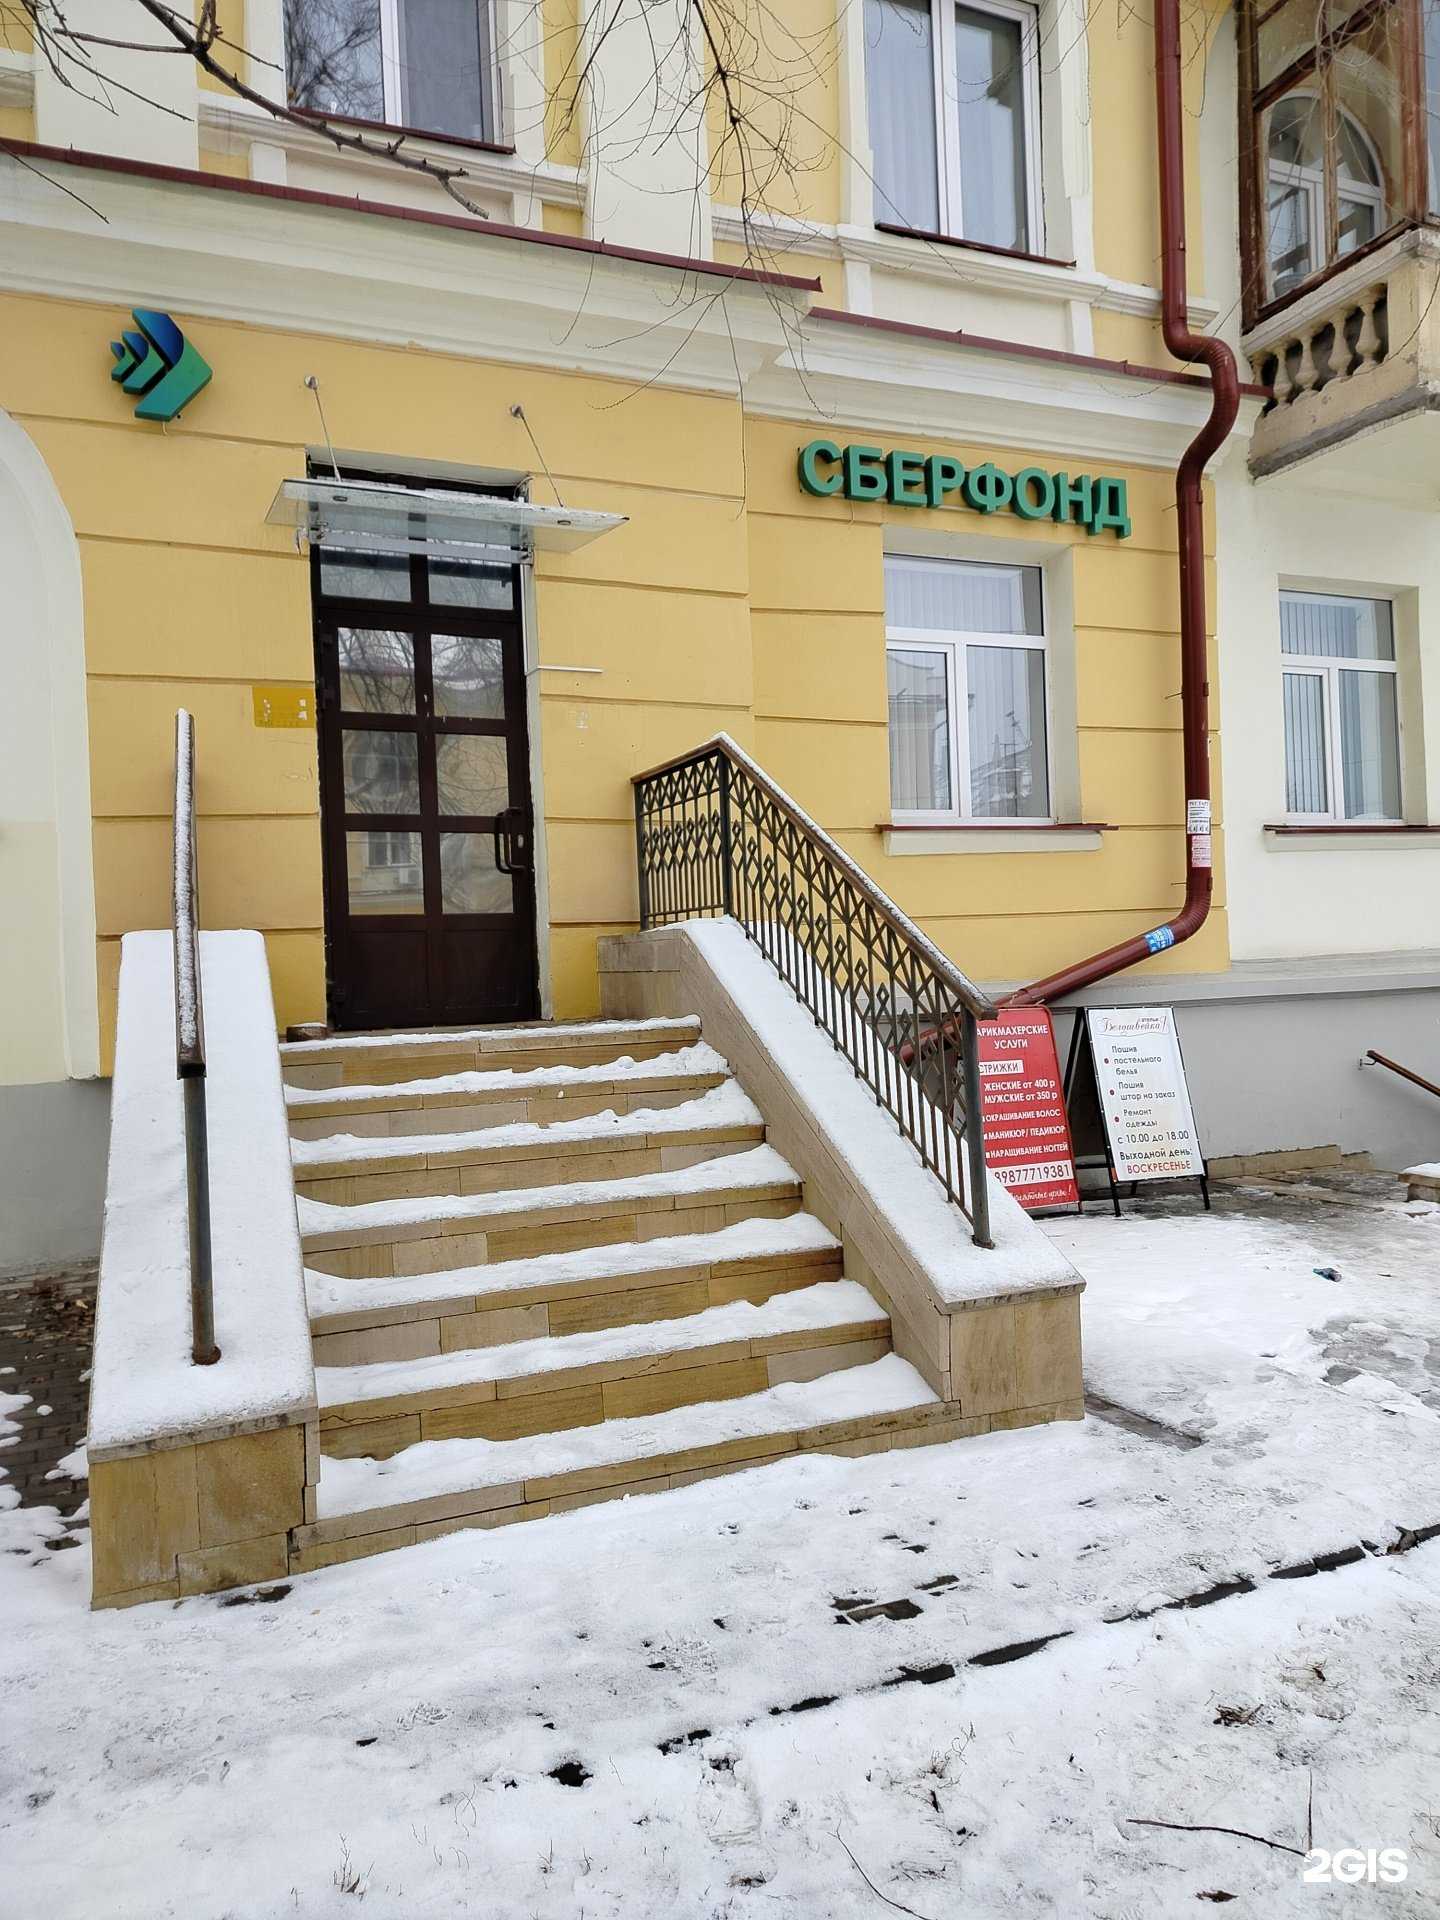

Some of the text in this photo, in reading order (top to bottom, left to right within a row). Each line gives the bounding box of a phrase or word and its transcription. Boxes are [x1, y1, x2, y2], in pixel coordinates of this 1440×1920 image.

[799, 439, 1131, 538] СБЕРФОНД
[976, 1024, 1048, 1037] АРИКМАХЕРСКИЕ
[994, 1039, 1028, 1050] УСЛУГИ
[1112, 1045, 1137, 1053] Пошив
[1113, 1056, 1162, 1064] постельного
[1116, 1067, 1138, 1075] белья
[984, 1081, 1022, 1092] ЖЕНСКИЕ
[1023, 1081, 1032, 1089] от
[1034, 1079, 1048, 1088] 400
[1118, 1081, 1144, 1089] Пошив
[984, 1093, 1025, 1104] МУЖСКИЕ
[1036, 1091, 1050, 1100] 350
[1120, 1093, 1141, 1101] штор
[1155, 1091, 1176, 1099] заказ
[986, 1109, 1061, 1122] ОКРАШИВАНИЕ ВОЛОС
[1125, 1120, 1158, 1128] одежды
[1030, 1125, 1066, 1137] ПЕДИКЮР
[1125, 1133, 1150, 1143] 10.00
[1152, 1134, 1164, 1142] до
[1166, 1130, 1189, 1140] 18.00
[990, 1142, 1069, 1158] НАРАЩИВАНИЕ НОГТЕЙ
[1120, 1148, 1193, 1160] Выходной день:
[1127, 1160, 1192, 1174] ВОСКРЕСЕНЬЕ
